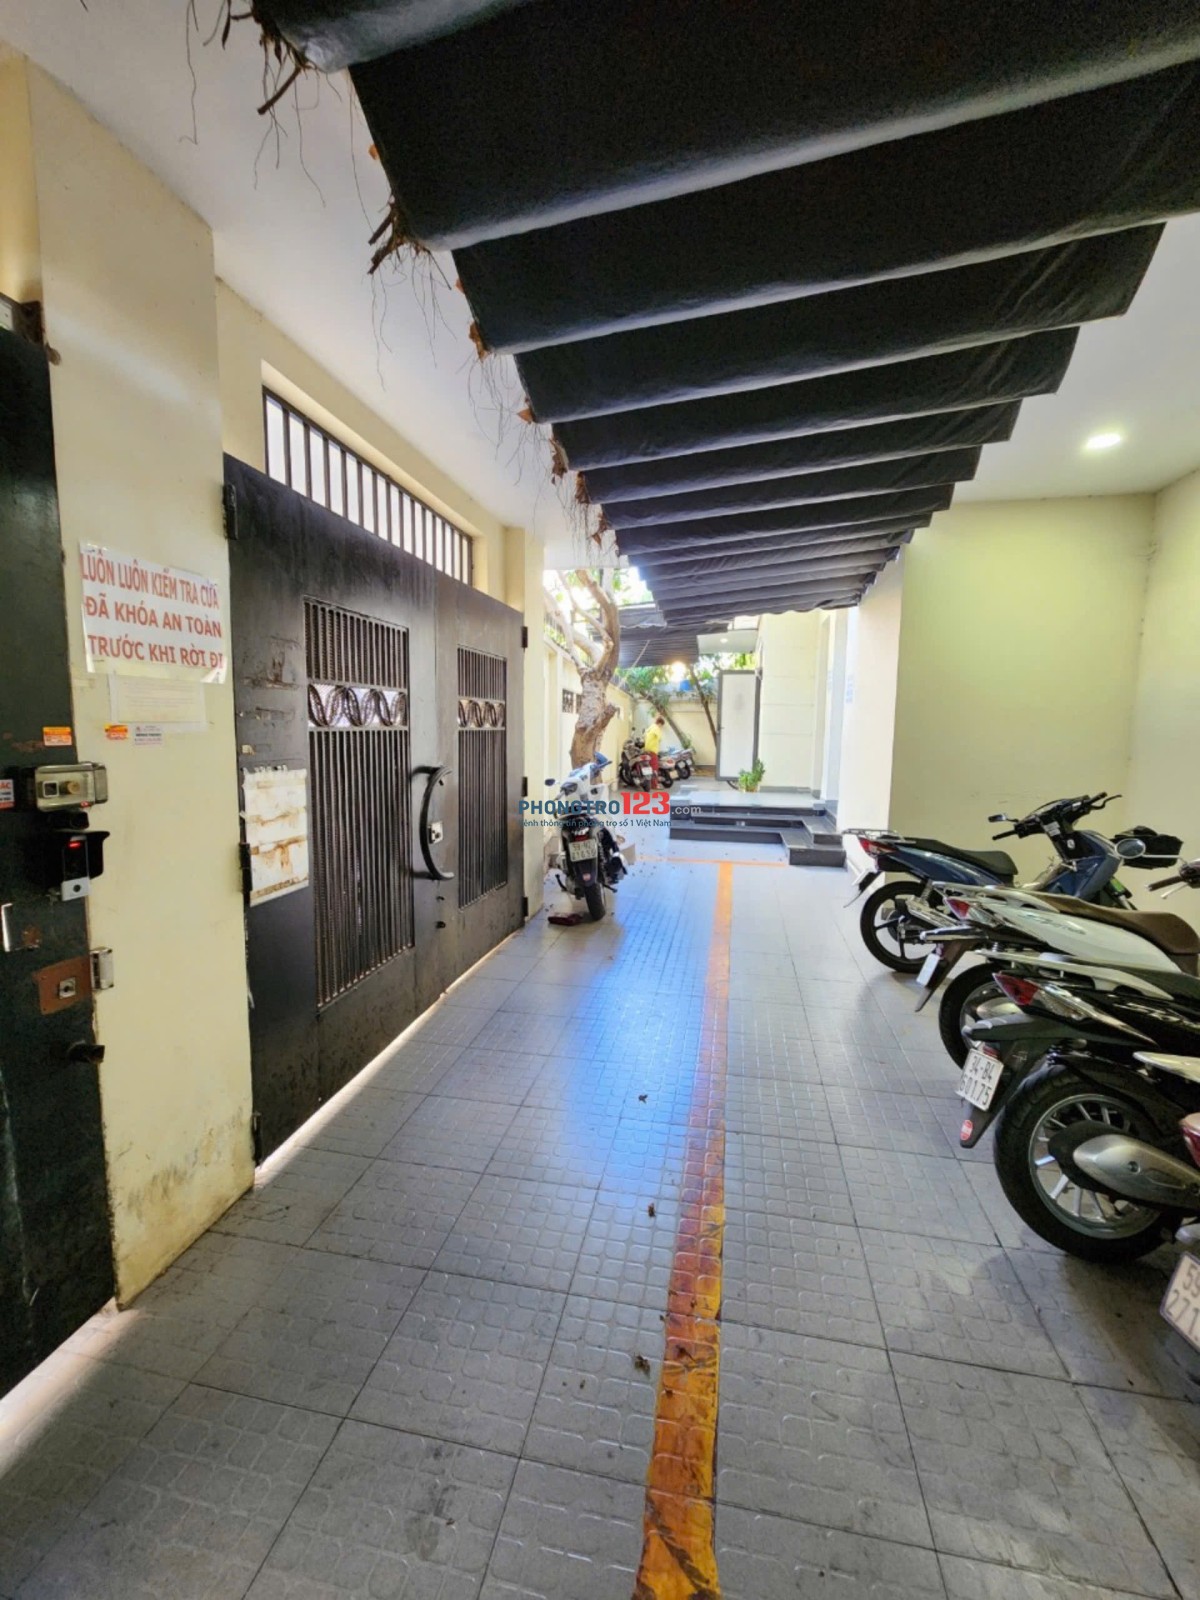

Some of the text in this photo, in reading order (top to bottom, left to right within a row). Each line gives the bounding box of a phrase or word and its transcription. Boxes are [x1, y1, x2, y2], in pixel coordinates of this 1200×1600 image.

[80, 549, 115, 587] LUÔN
[118, 559, 149, 595] LUÔN
[179, 580, 200, 605] TRA
[85, 593, 223, 638] ĐÃ KHÓA AN TOÀN
[87, 634, 224, 669] TRƯỚC KHI RỜI ĐI
